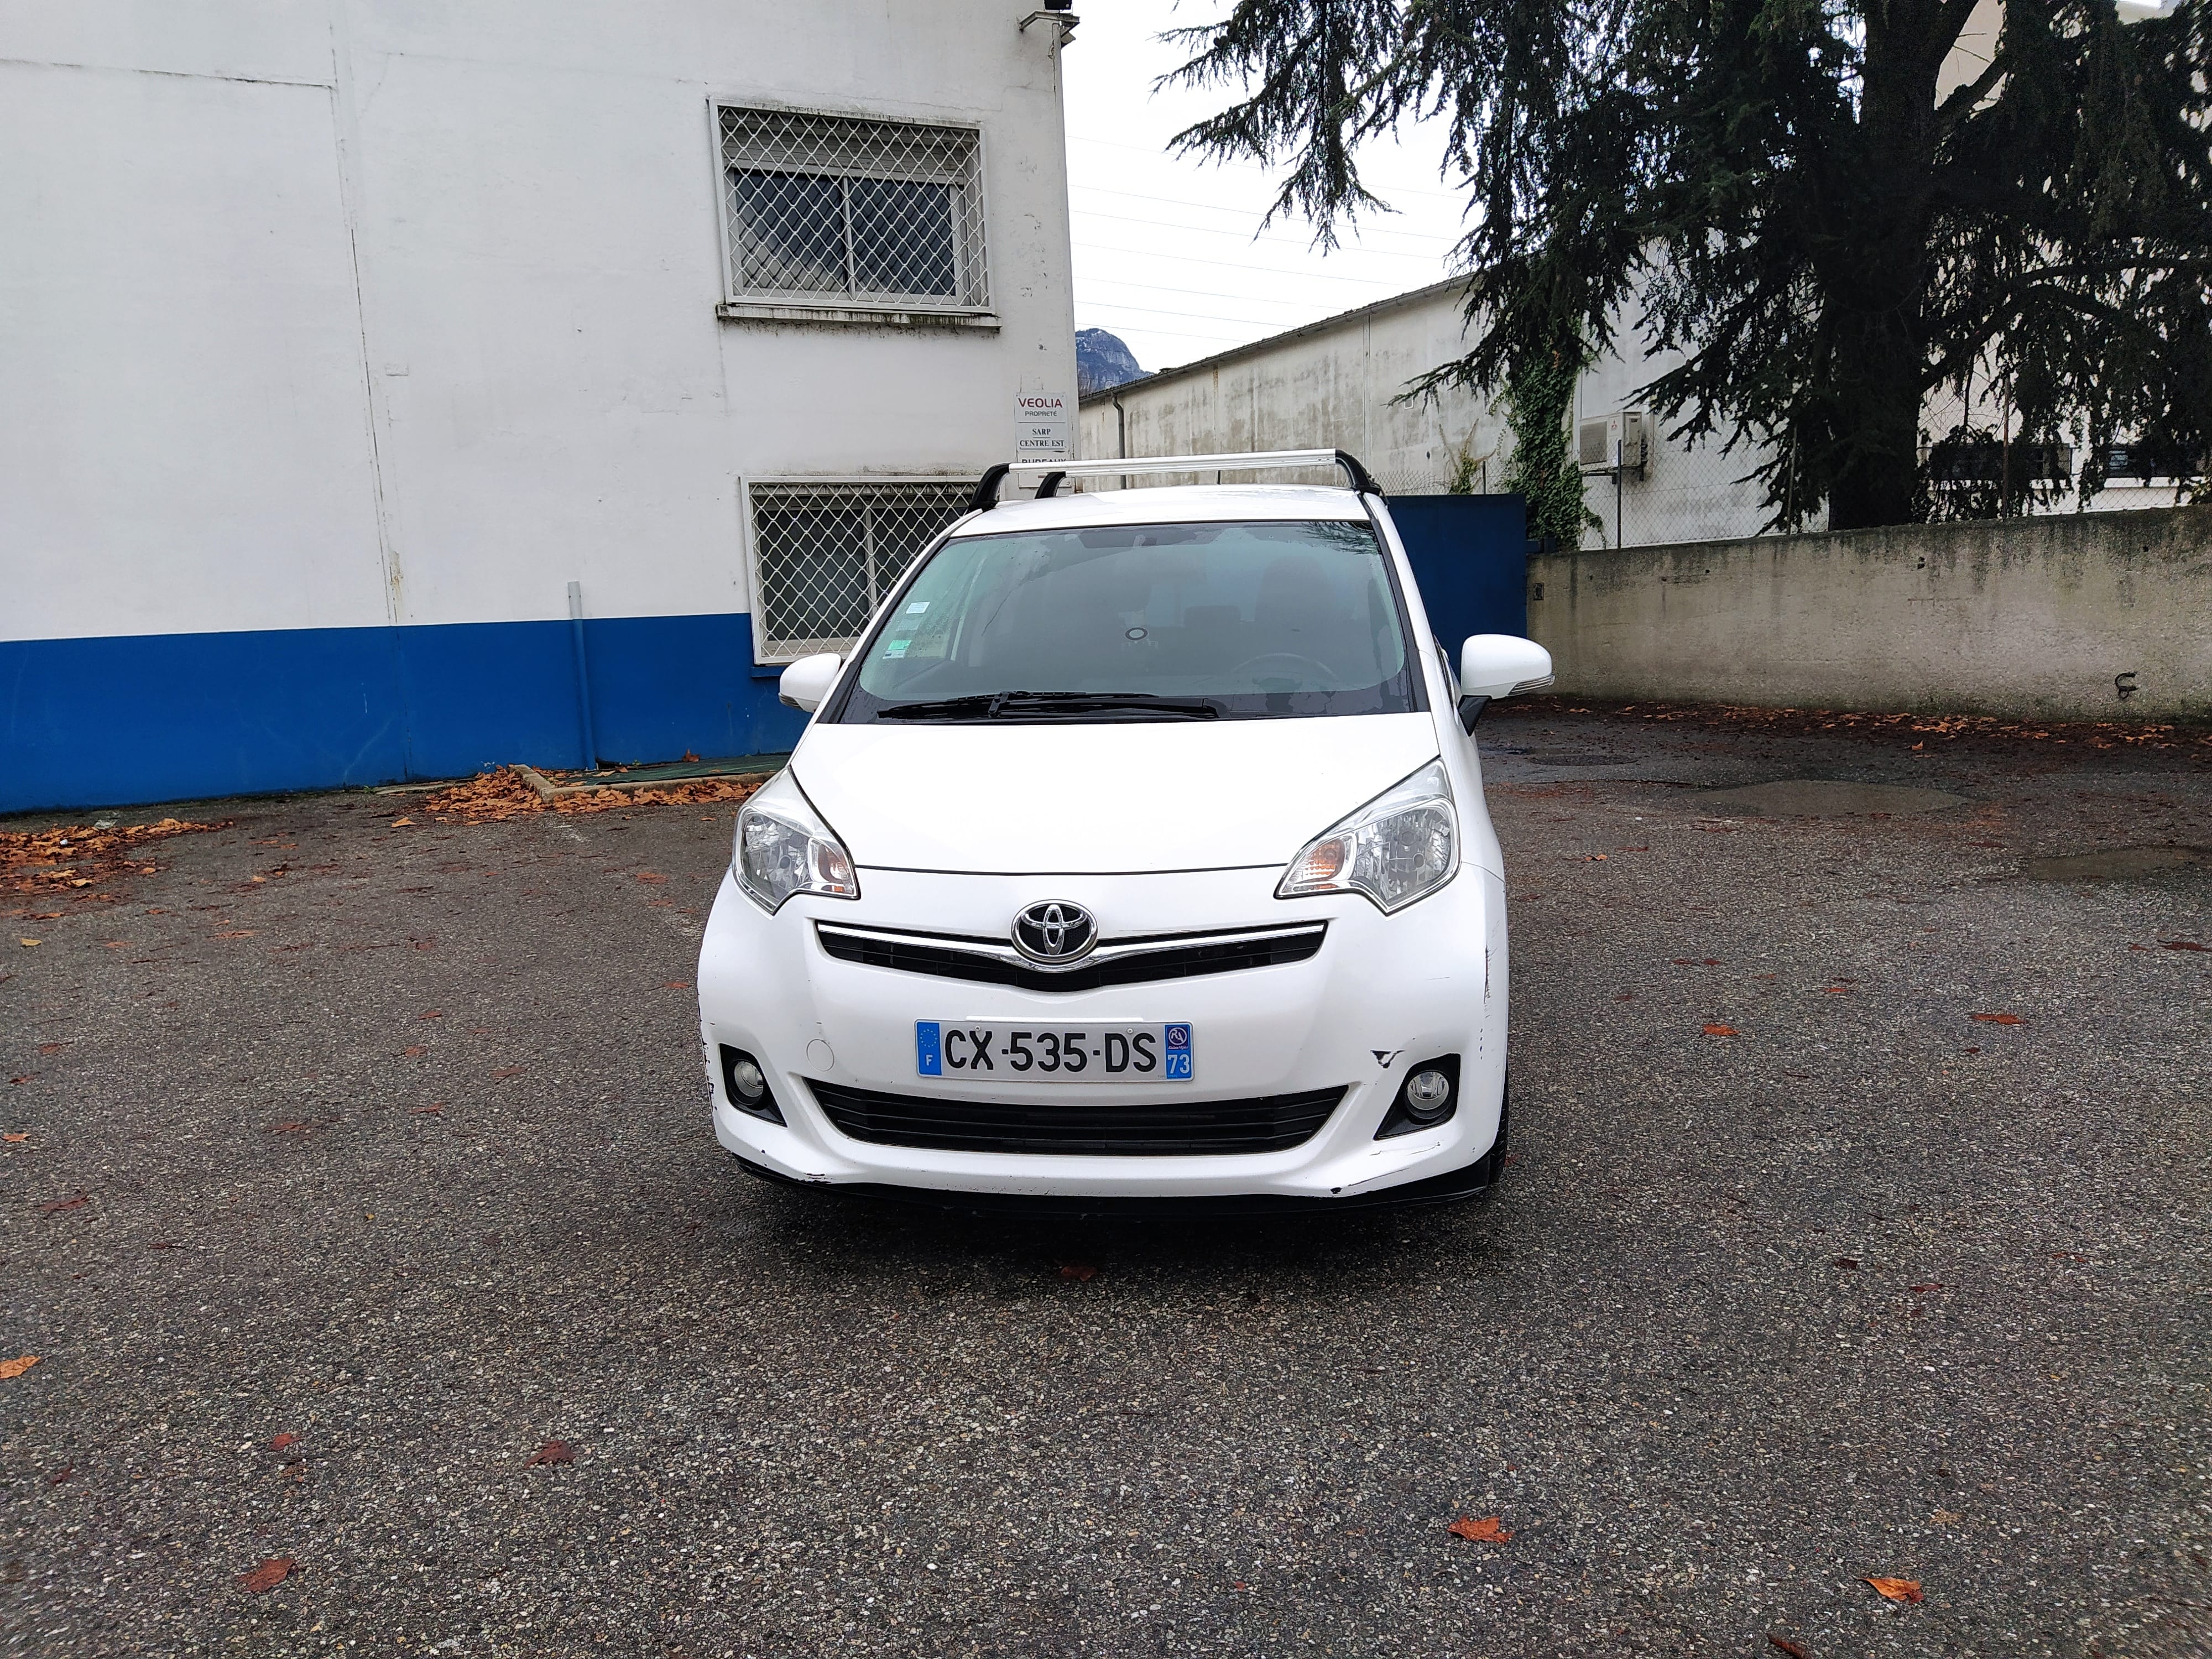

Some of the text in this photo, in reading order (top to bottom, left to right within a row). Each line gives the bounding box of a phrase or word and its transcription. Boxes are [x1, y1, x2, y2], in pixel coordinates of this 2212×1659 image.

[1018, 398, 1063, 408] VEOLIA
[945, 1030, 1156, 1072] CX-535-DS
[926, 1054, 933, 1066] F
[1168, 1054, 1190, 1073] 73
